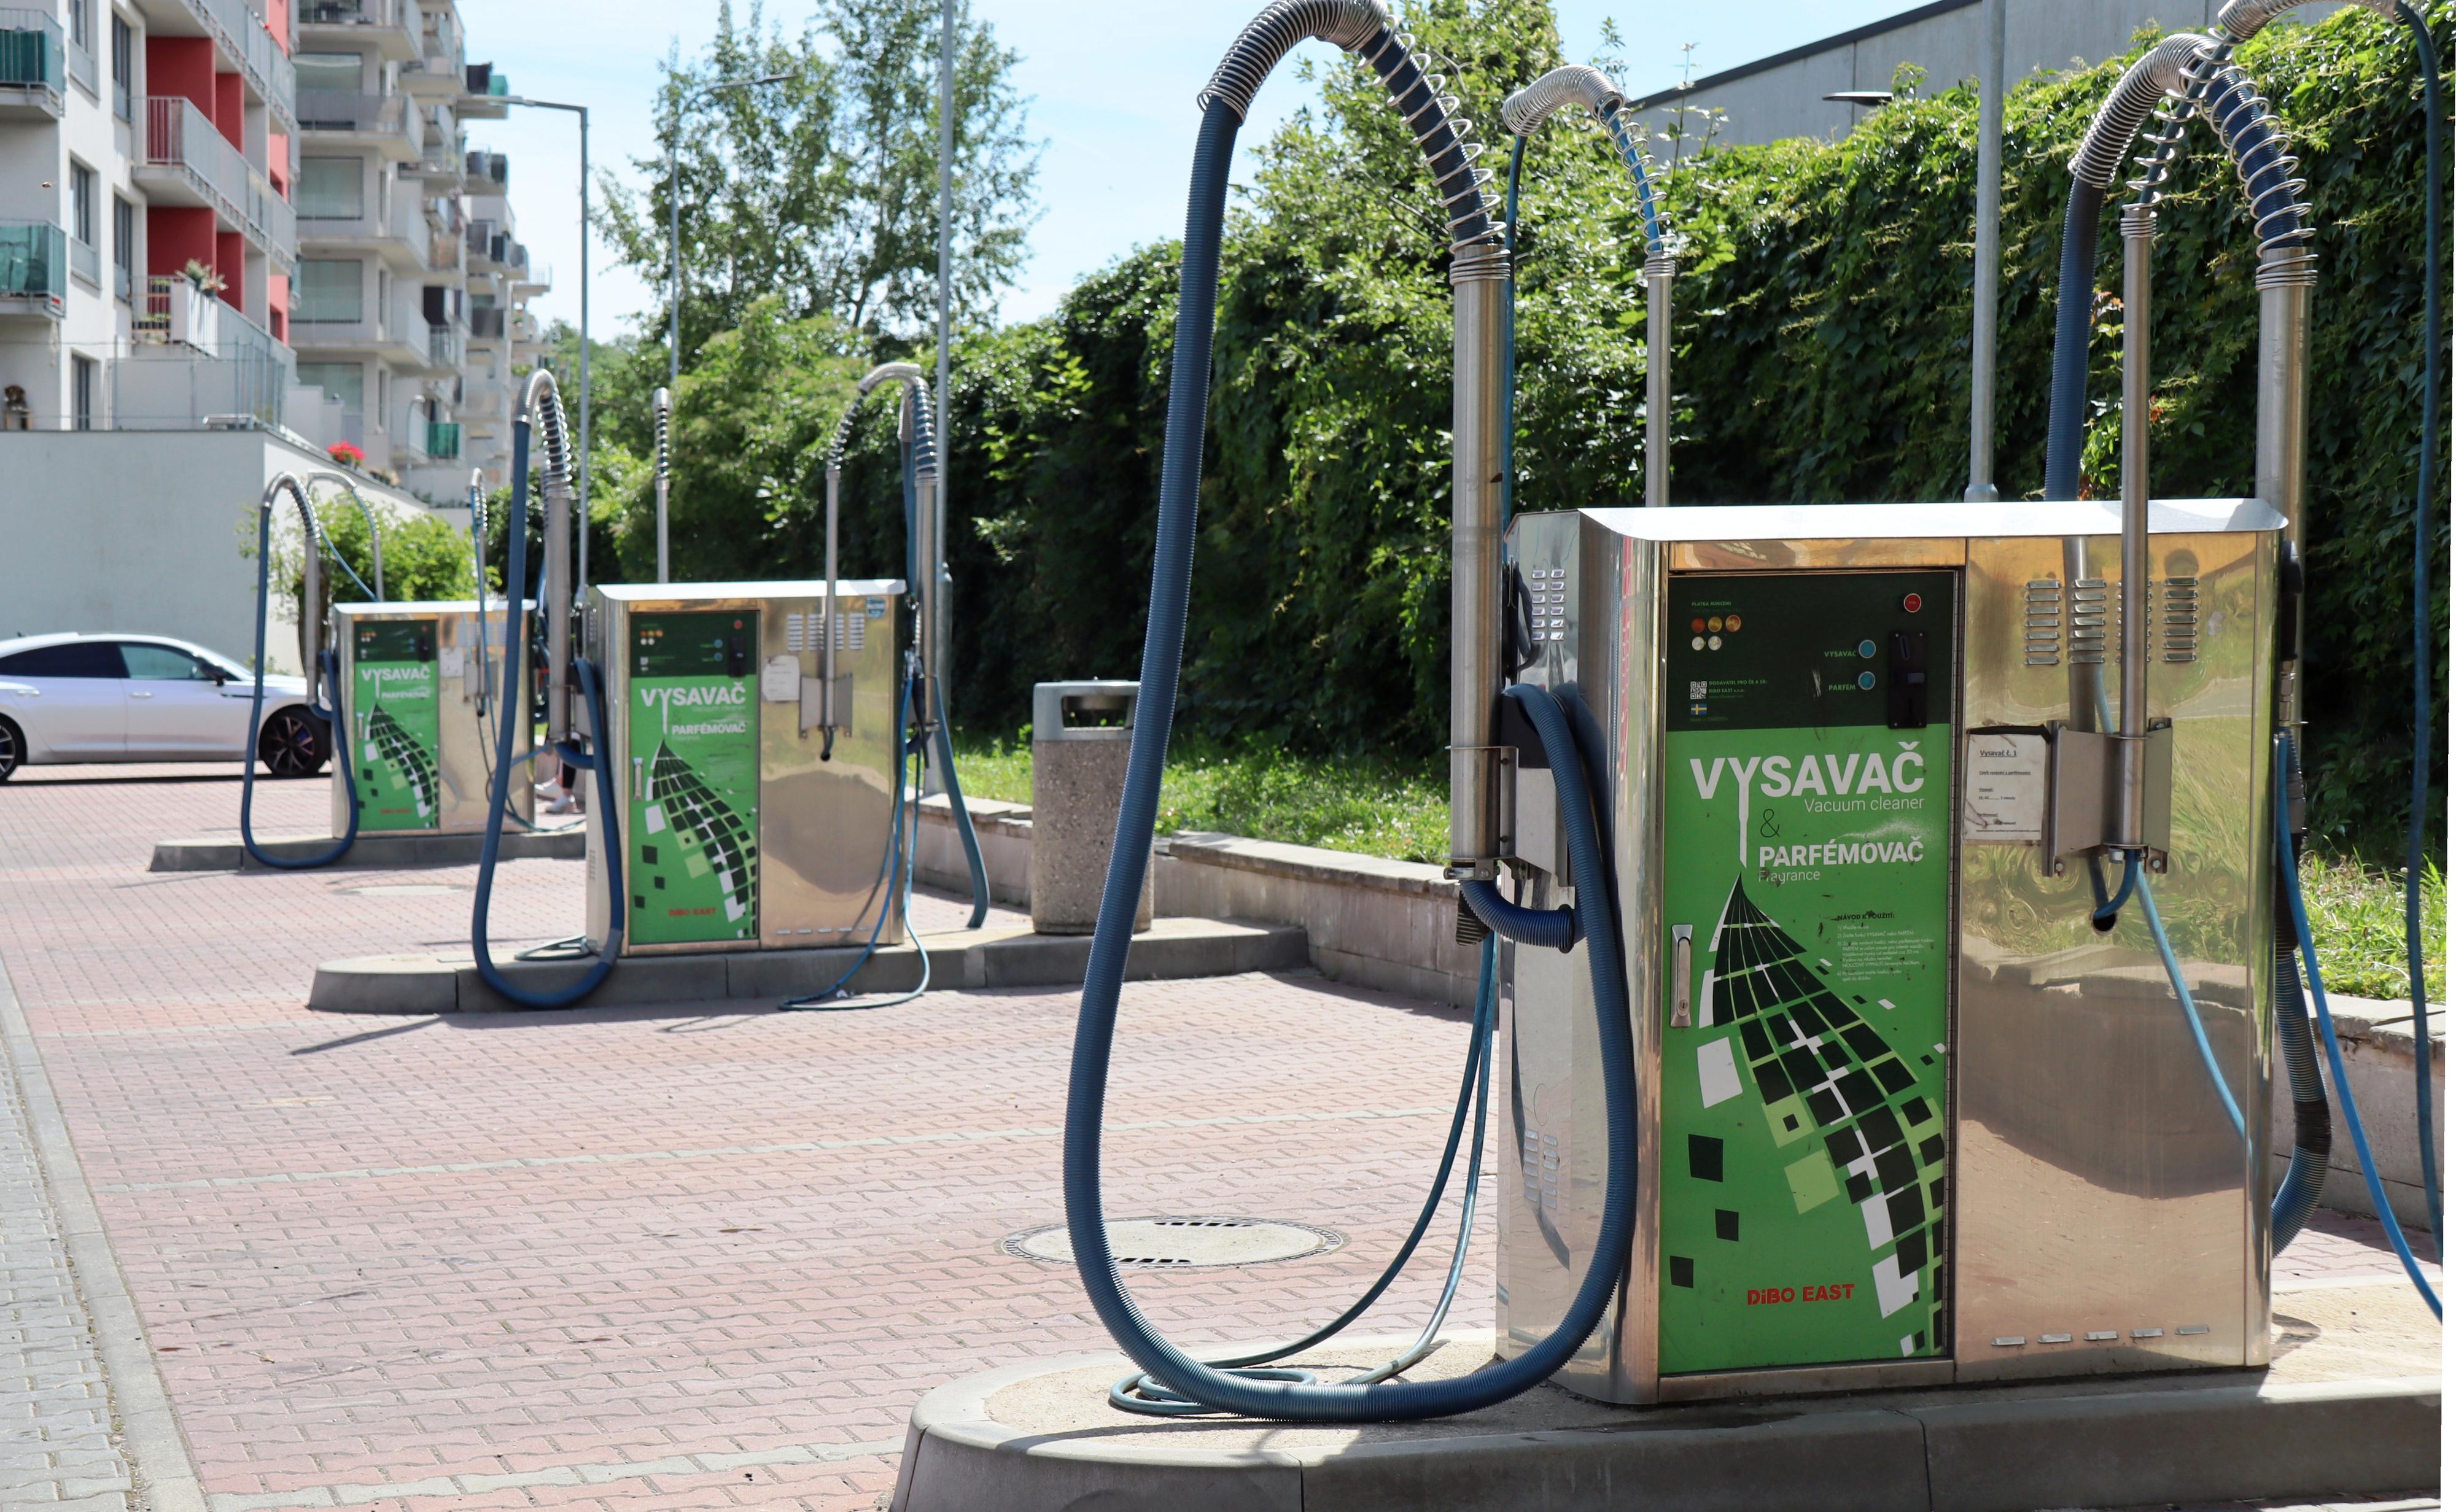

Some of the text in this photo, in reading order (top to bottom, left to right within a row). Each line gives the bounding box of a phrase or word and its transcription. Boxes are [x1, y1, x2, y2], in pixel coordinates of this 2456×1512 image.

[672, 722, 746, 735] PARFÉMOVAČ
[1804, 796, 1924, 813] Vacuum cleaner
[1760, 808, 1780, 838] &
[1759, 836, 1924, 867] PARFÉMOVAČ
[1758, 870, 1821, 885] Fragrance
[1747, 1284, 1855, 1305] DiBO EAST
